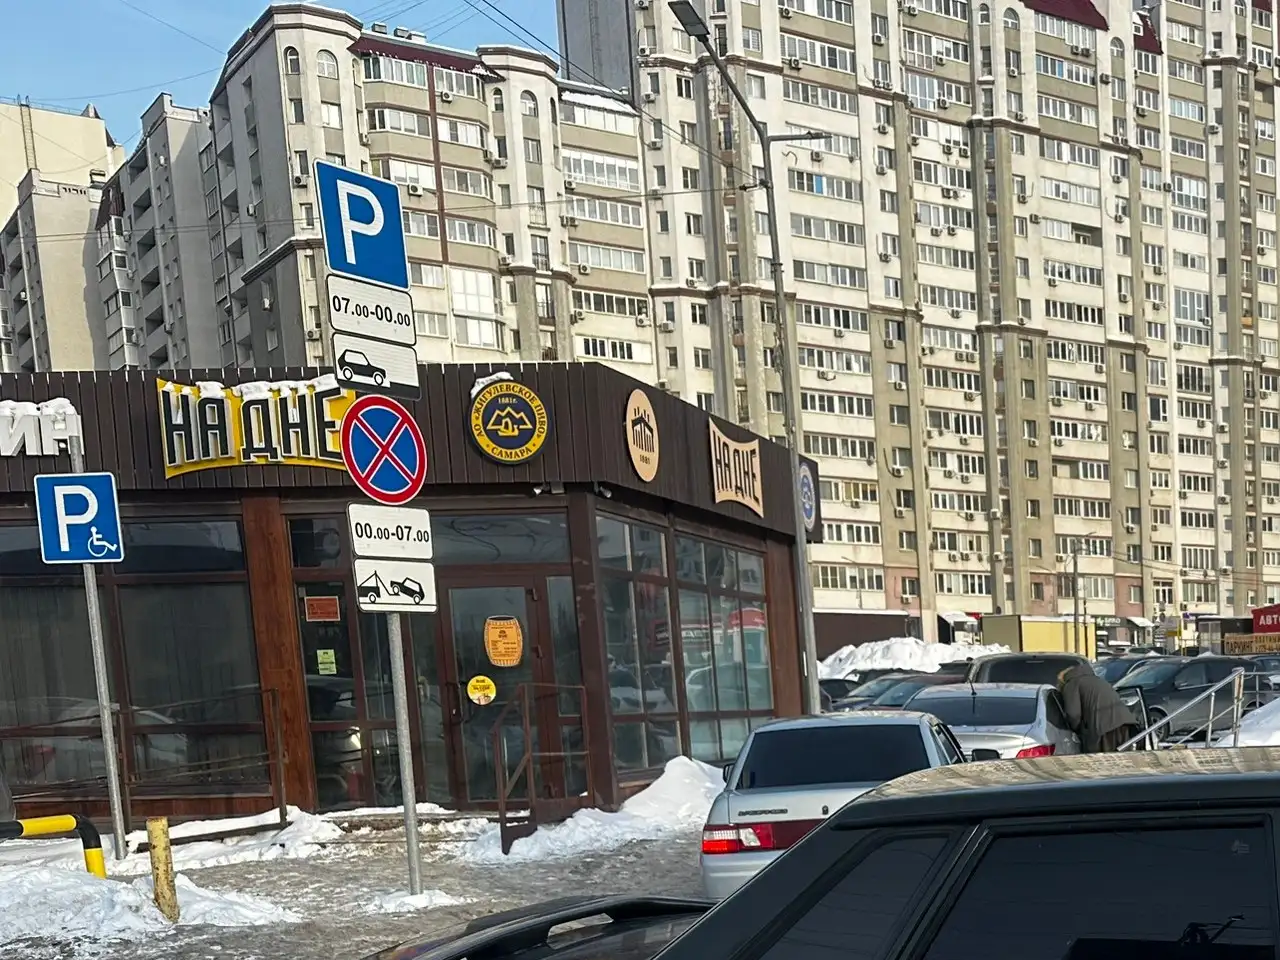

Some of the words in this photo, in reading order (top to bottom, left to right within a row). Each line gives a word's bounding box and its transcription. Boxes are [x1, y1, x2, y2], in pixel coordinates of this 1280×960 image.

[337, 179, 385, 265] P
[332, 295, 411, 327] 07.00-00.00
[160, 387, 236, 467] НА
[239, 386, 345, 463] ДНЕ
[491, 445, 533, 459] САМАРА
[712, 429, 734, 492] НА
[733, 447, 761, 506] ДНЕ
[54, 485, 99, 552] P
[354, 522, 430, 543] 00.00-07.00
